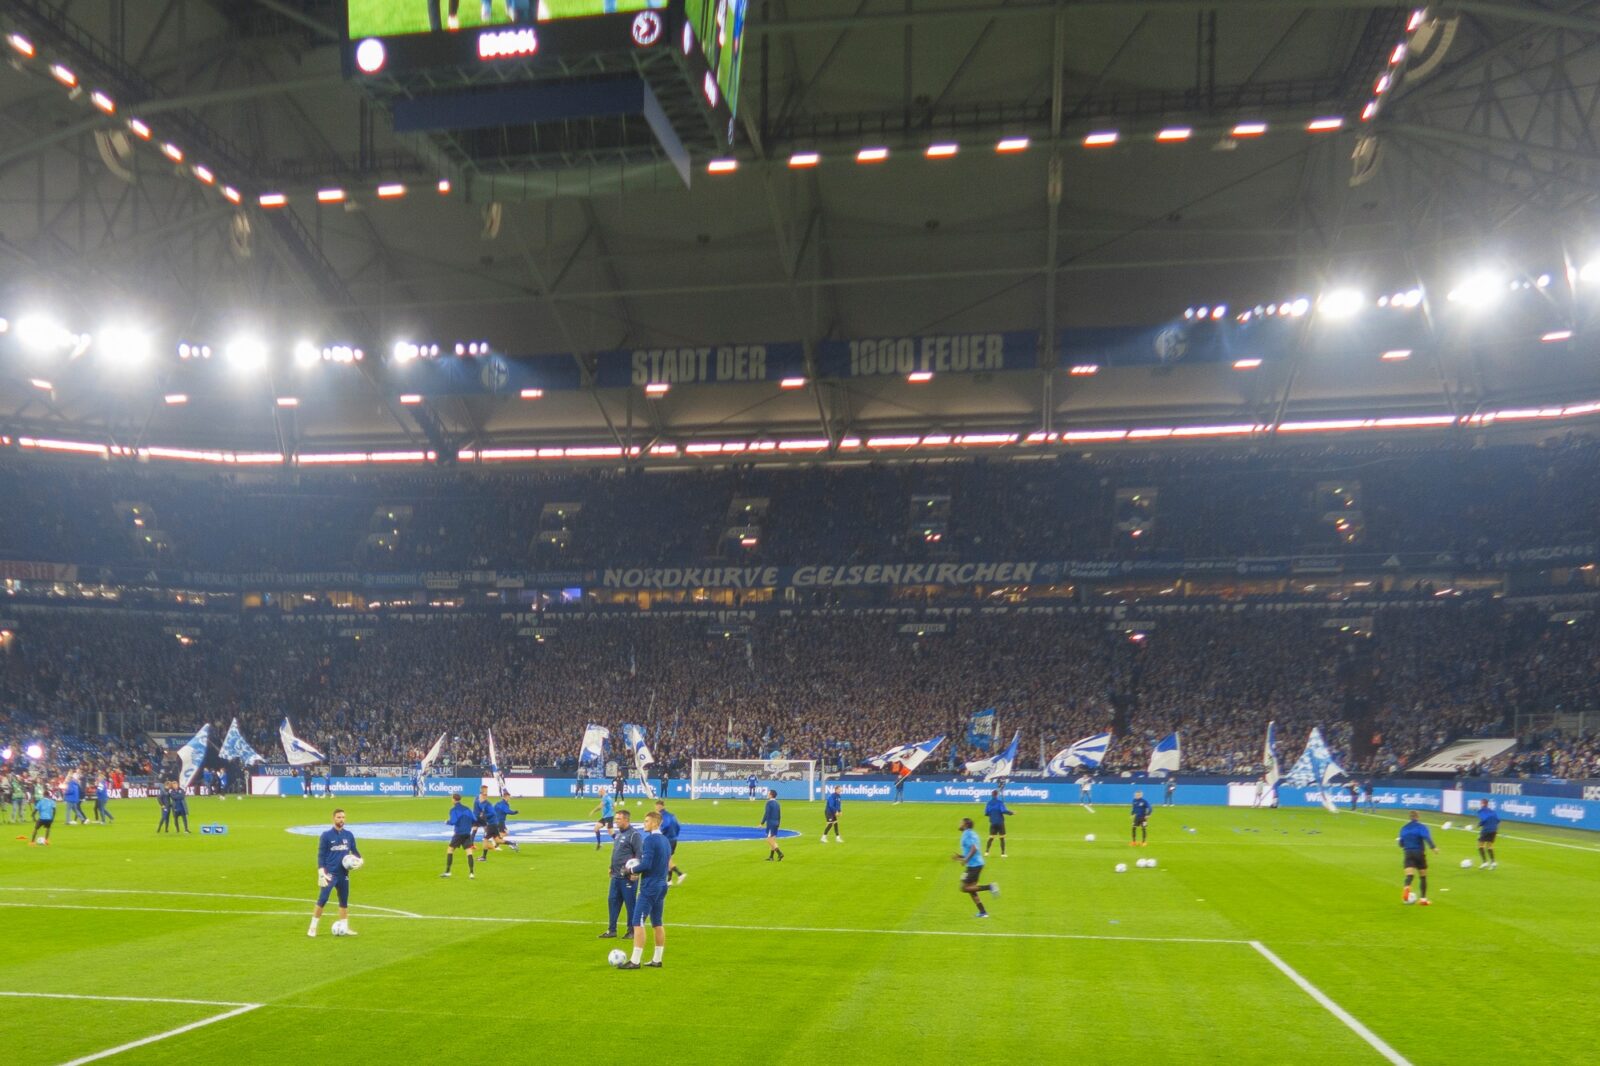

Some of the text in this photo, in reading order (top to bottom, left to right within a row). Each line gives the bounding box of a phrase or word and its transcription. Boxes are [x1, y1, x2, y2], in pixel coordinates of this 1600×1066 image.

[632, 347, 711, 385] STADT
[717, 345, 767, 382] DER
[920, 335, 1004, 372] FEUER
[602, 567, 779, 590] NORDKURVE
[792, 562, 1037, 588] GELSENKIRCHEN
[128, 788, 147, 798] BRAX
[300, 781, 375, 791] Wirtsaftskanzlei
[380, 782, 417, 795] Spellbrin
[429, 783, 463, 795] Kollegen
[824, 784, 891, 797] Nhhaltigkeit
